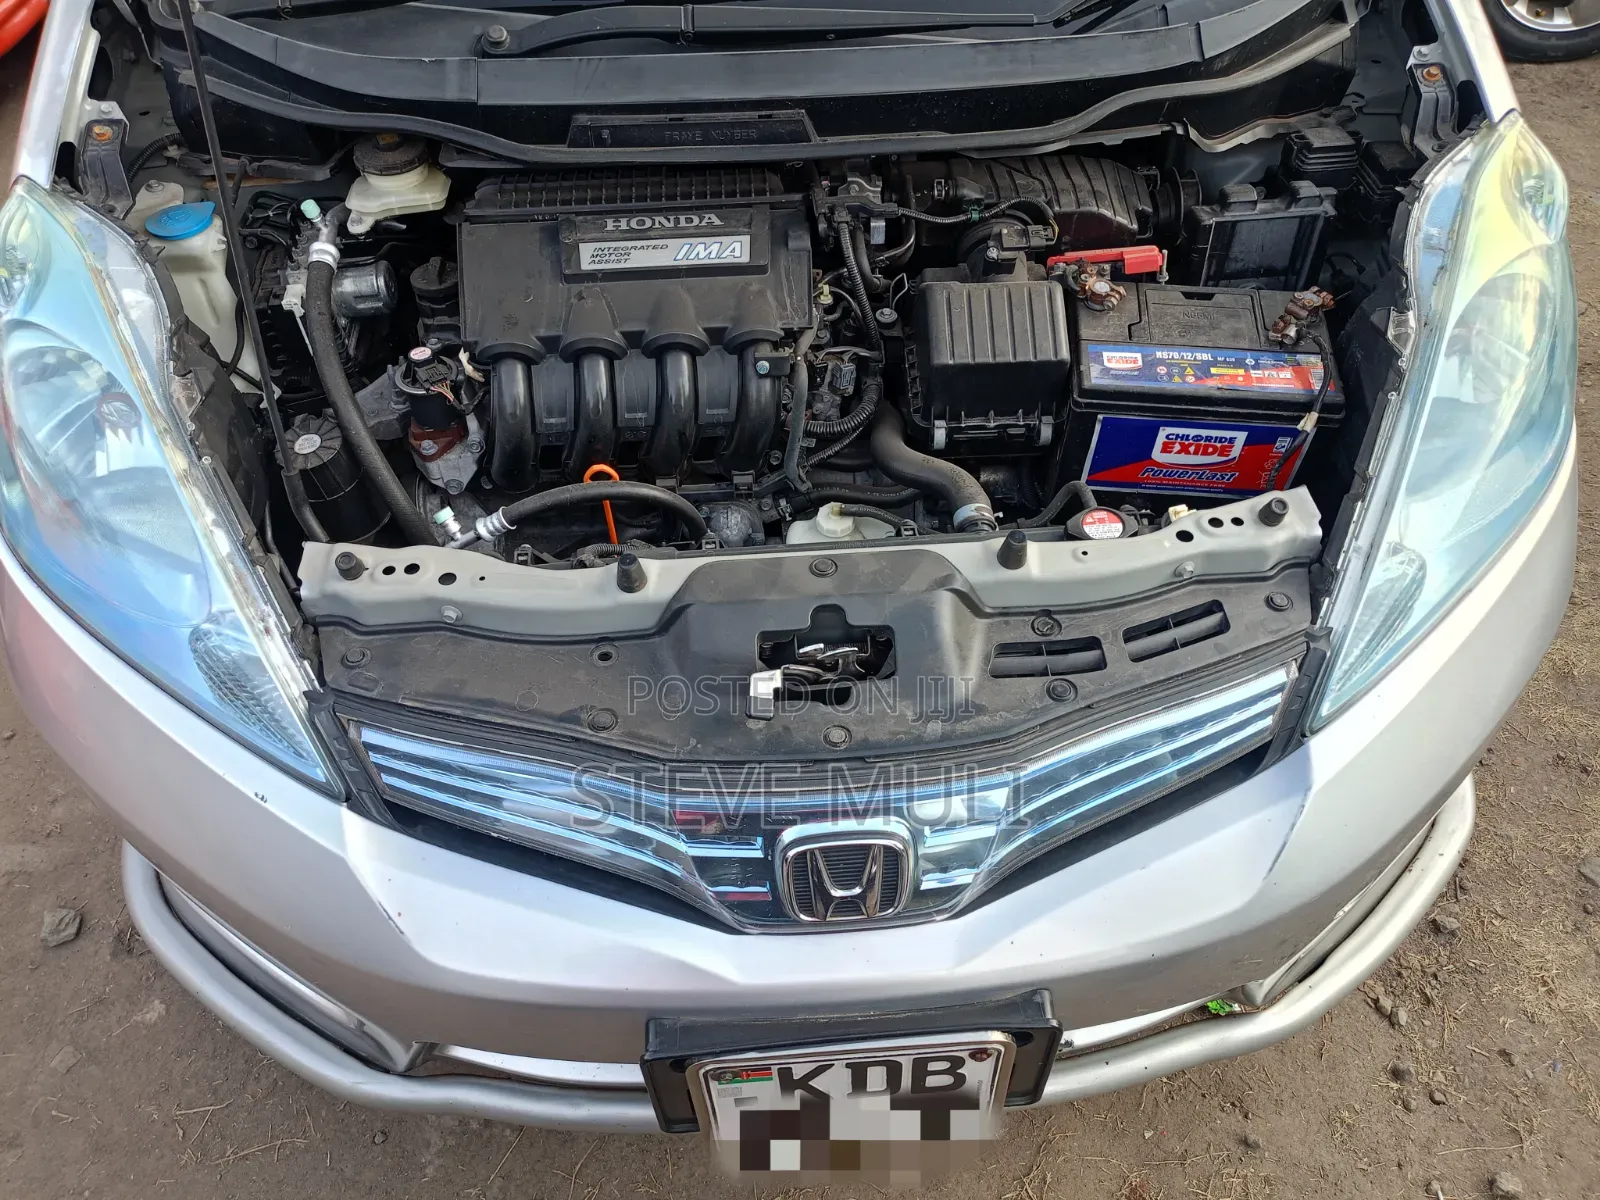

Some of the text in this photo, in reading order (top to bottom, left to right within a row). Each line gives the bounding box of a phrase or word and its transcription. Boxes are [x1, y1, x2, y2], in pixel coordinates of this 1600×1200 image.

[664, 129, 757, 141] FRAME NUMBER
[604, 213, 724, 231] HONDA
[593, 244, 669, 252] INTEGRATED
[673, 240, 743, 261] IMA
[1165, 432, 1238, 445] CHLORIDE
[1160, 441, 1235, 457] EXIDE
[1139, 467, 1239, 482] PowerLast
[777, 1055, 967, 1101] KDB
